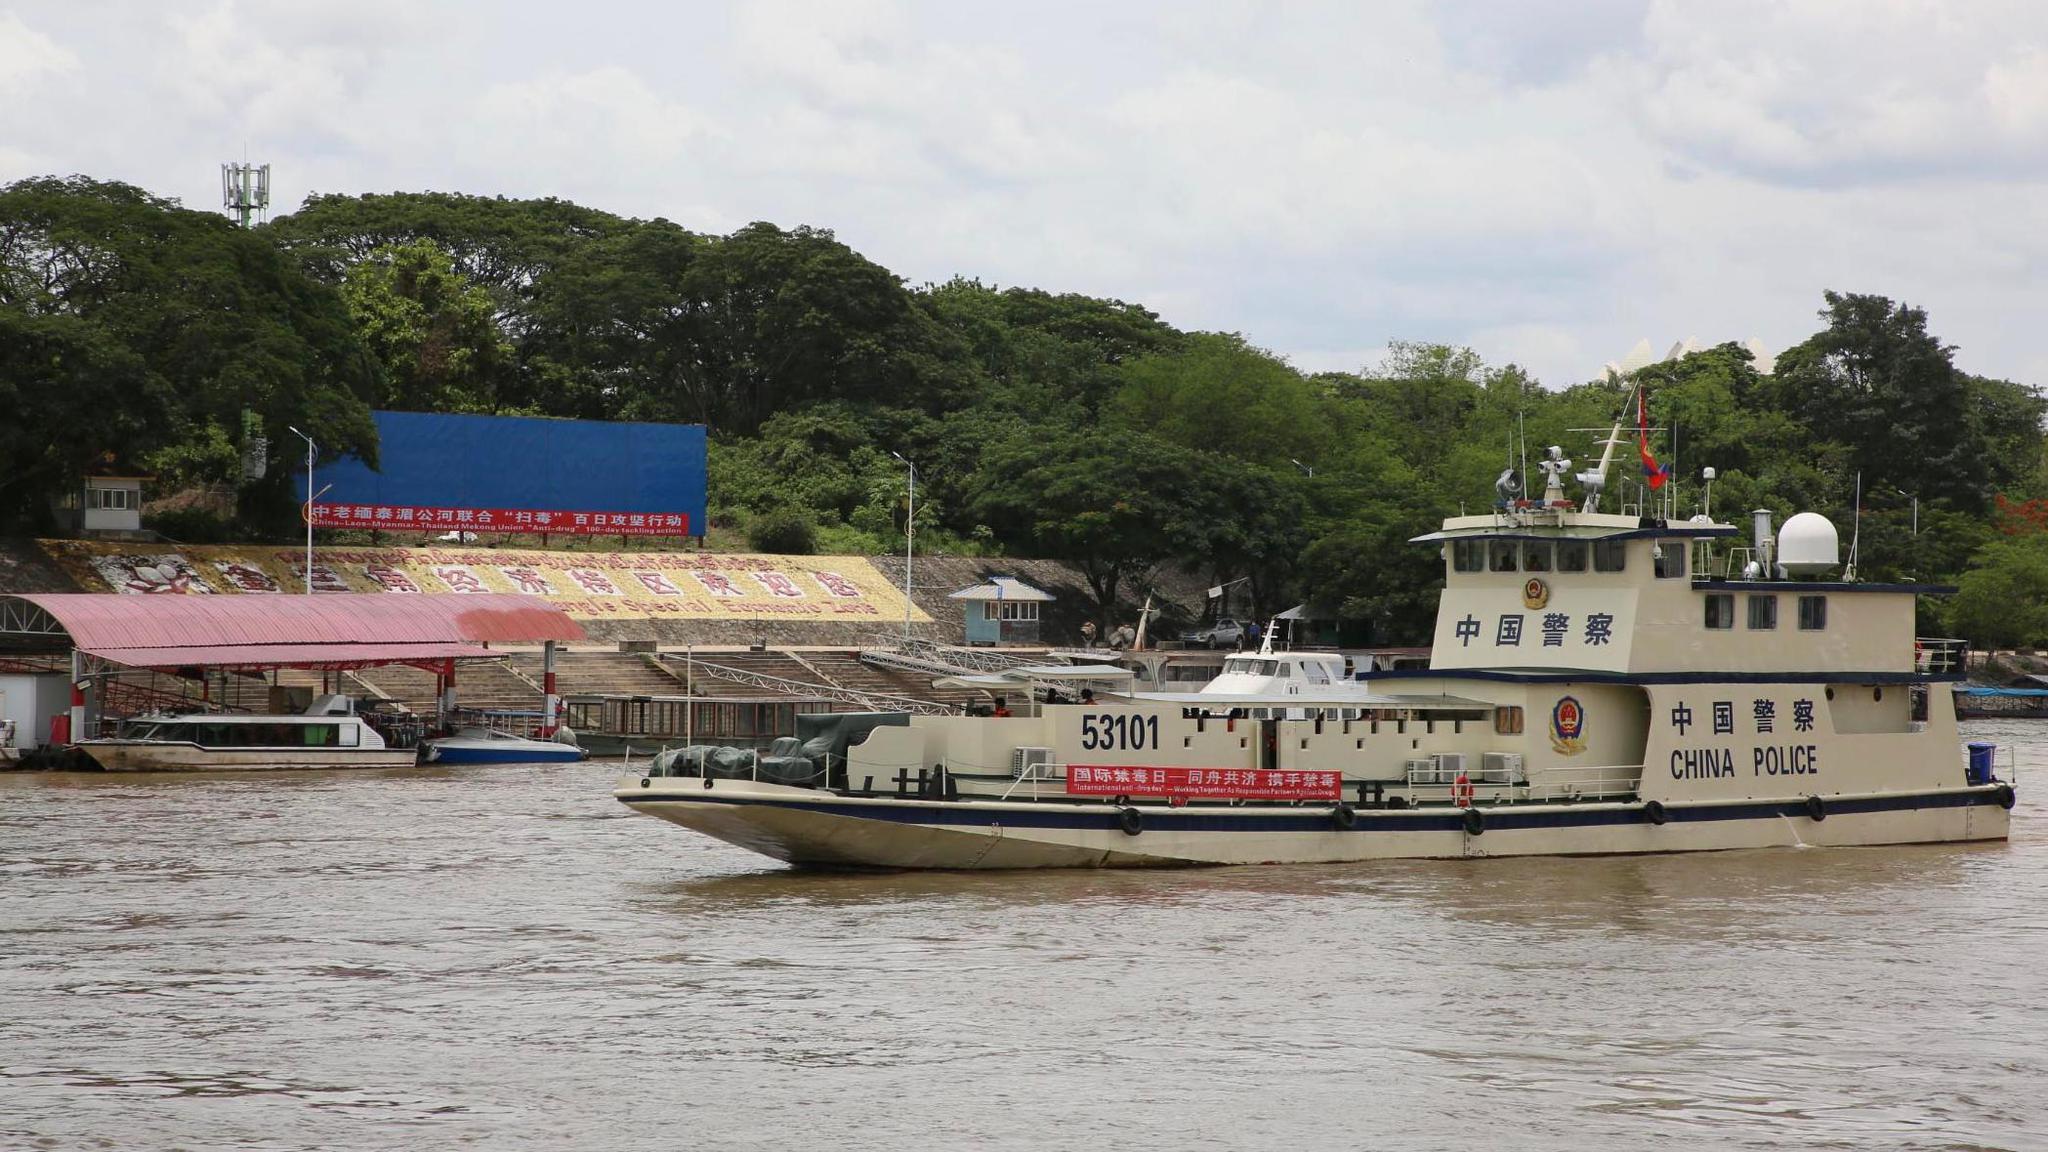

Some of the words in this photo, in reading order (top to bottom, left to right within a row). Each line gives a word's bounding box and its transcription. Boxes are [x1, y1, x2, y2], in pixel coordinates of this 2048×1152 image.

[312, 505, 494, 523] 中老缅泰湄公河联合
[505, 511, 563, 524] “扫毒”
[573, 513, 683, 527] 百日攻坚行动
[461, 523, 497, 531] Mekong
[551, 598, 617, 616] angle
[1456, 613, 1613, 647] 中国警察
[1671, 699, 1814, 736] 中国警察
[1082, 714, 1158, 750] 53101
[1671, 748, 1735, 779] CHINA
[1754, 745, 1817, 776] POLICE
[1268, 772, 1335, 787] 携手禁毒
